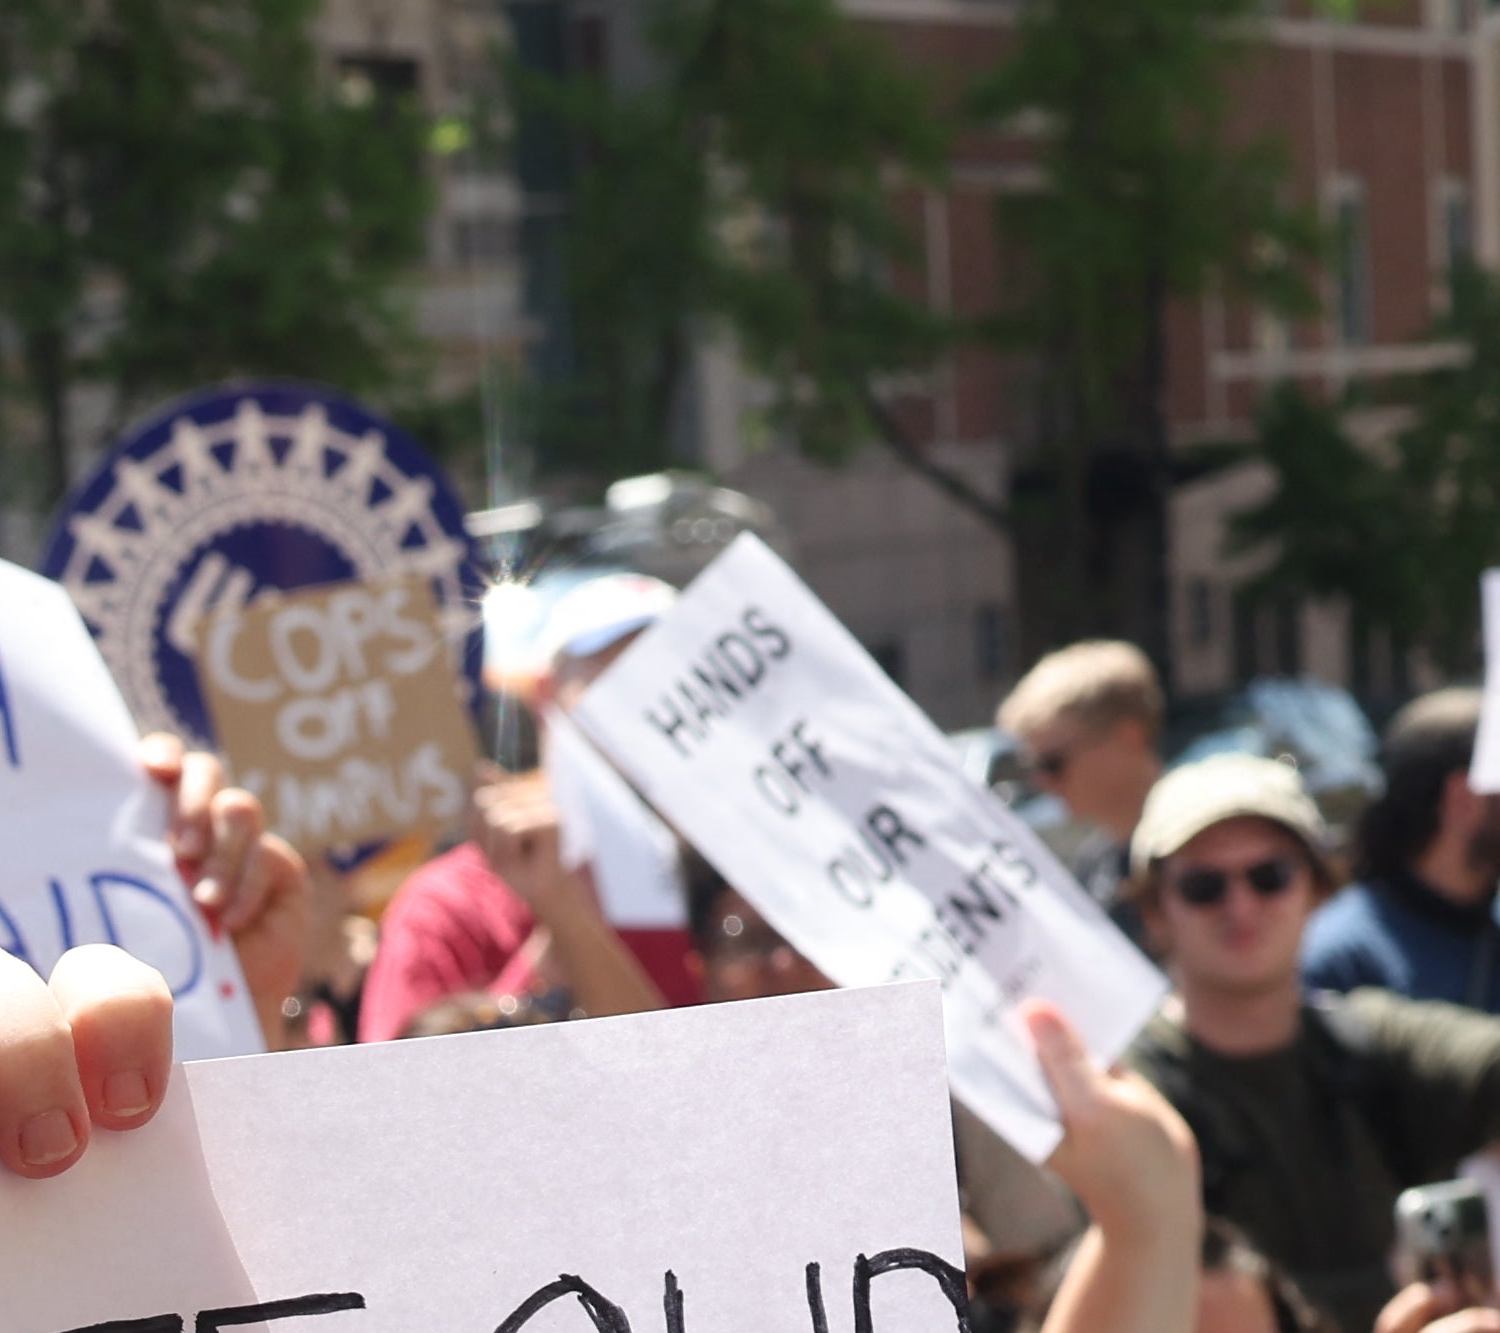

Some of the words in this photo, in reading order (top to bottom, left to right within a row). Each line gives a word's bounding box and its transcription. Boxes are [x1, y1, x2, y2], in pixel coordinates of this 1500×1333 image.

[208, 584, 434, 702] COPS
[643, 605, 794, 758] HANDS
[752, 718, 838, 818] OFF
[827, 802, 925, 909] OUR
